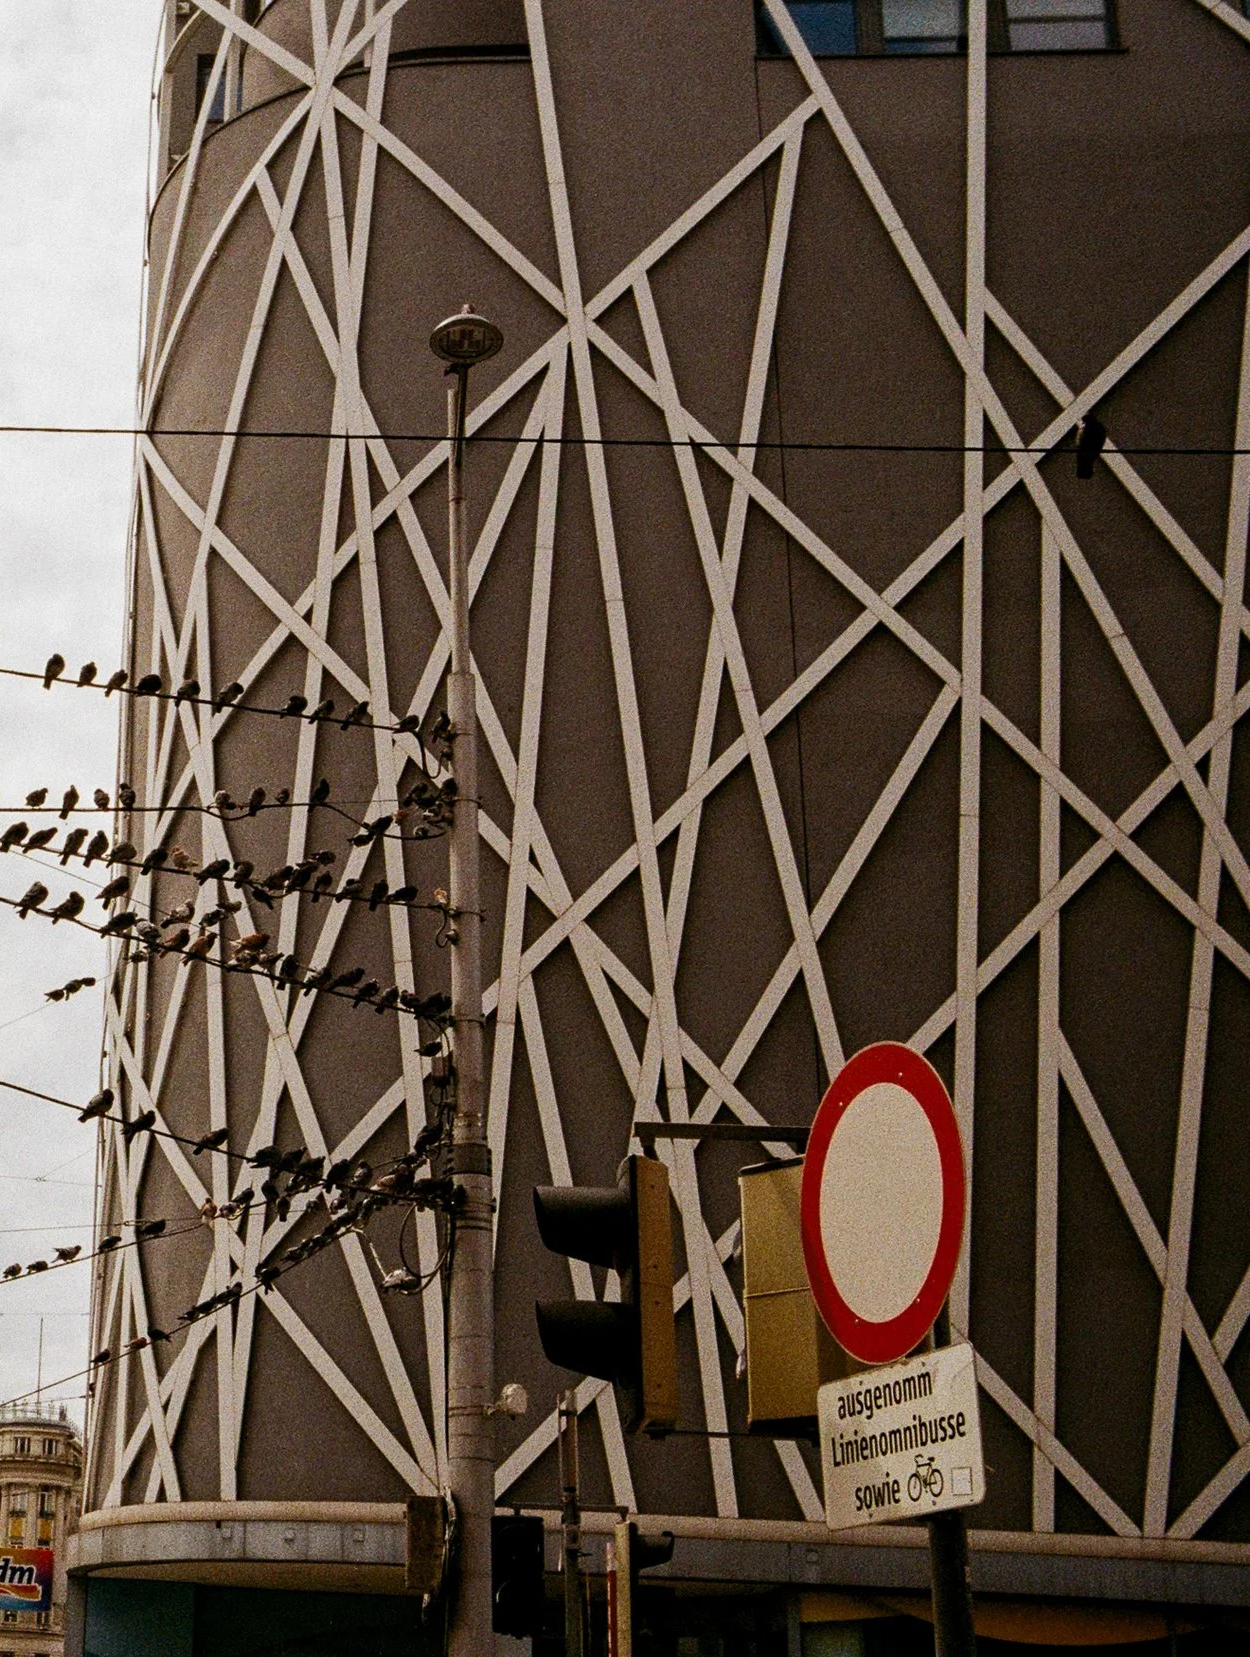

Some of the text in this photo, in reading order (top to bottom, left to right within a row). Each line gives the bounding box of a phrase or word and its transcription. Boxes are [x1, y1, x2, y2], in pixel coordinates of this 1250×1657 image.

[837, 1371, 932, 1420] ausgenomm
[831, 1411, 966, 1467] Linienomnibusse
[855, 1471, 900, 1511] sowie
